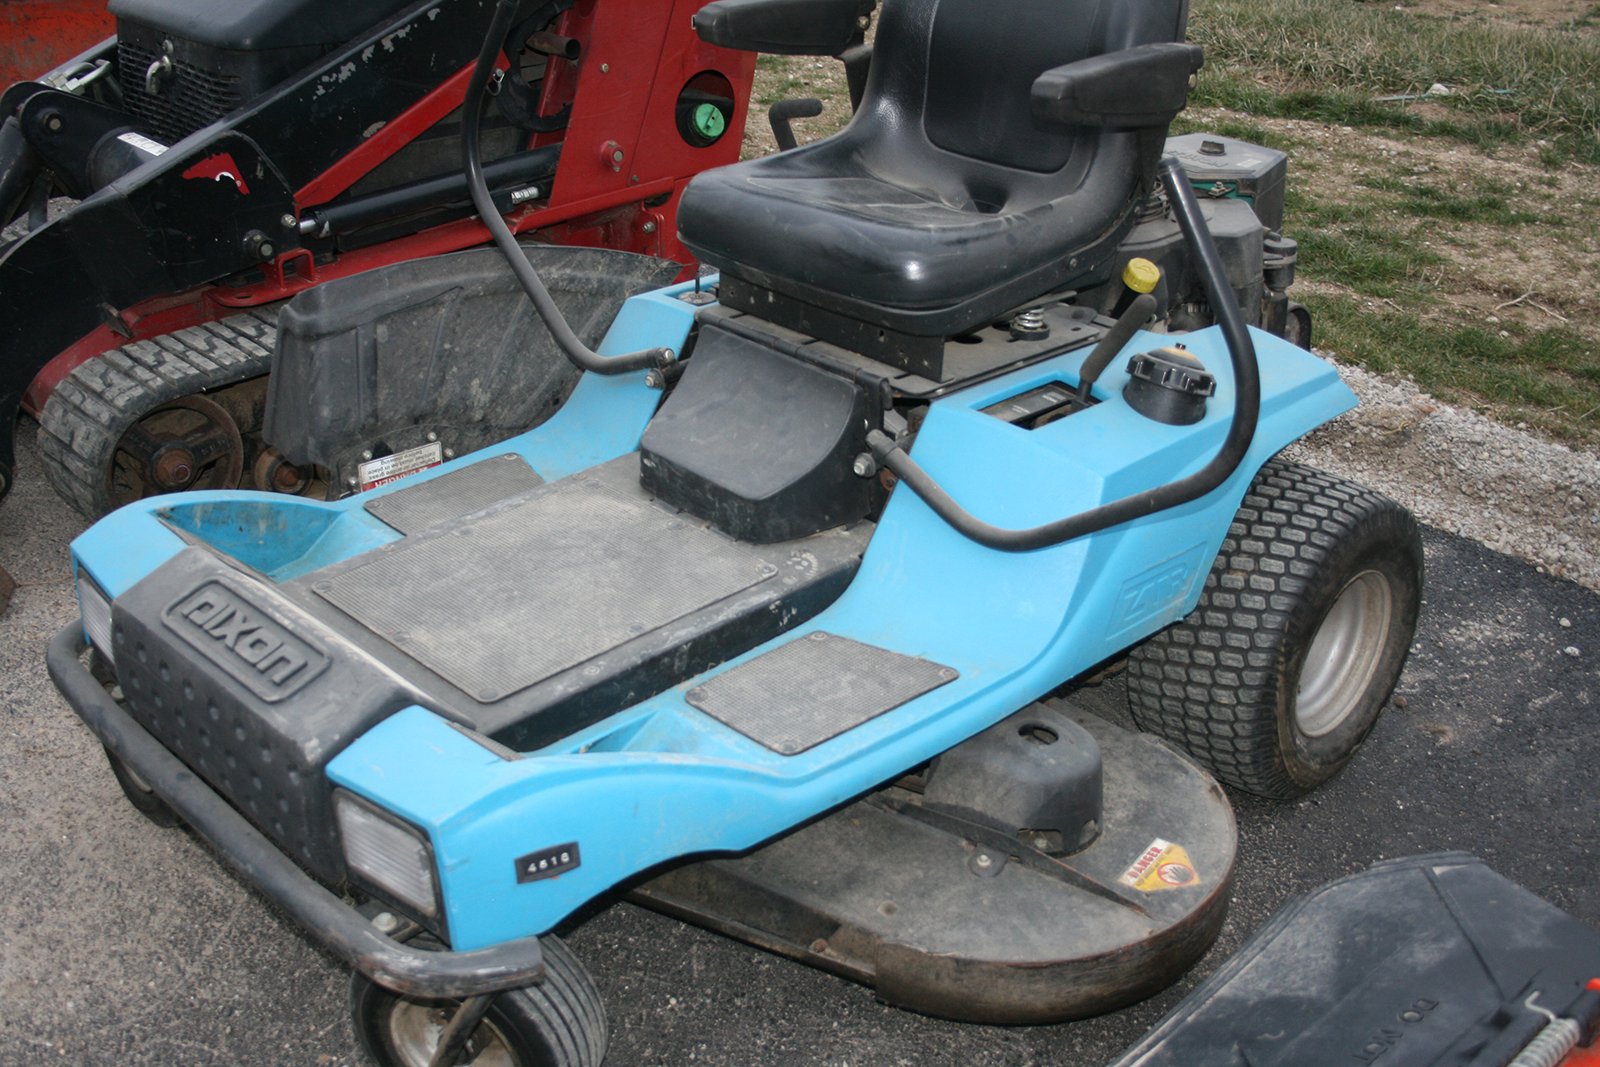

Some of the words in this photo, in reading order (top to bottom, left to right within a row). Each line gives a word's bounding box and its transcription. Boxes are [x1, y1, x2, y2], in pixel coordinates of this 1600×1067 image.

[367, 466, 384, 475] place
[1126, 846, 1163, 879] DANGER
[1398, 998, 1440, 1023] DO
